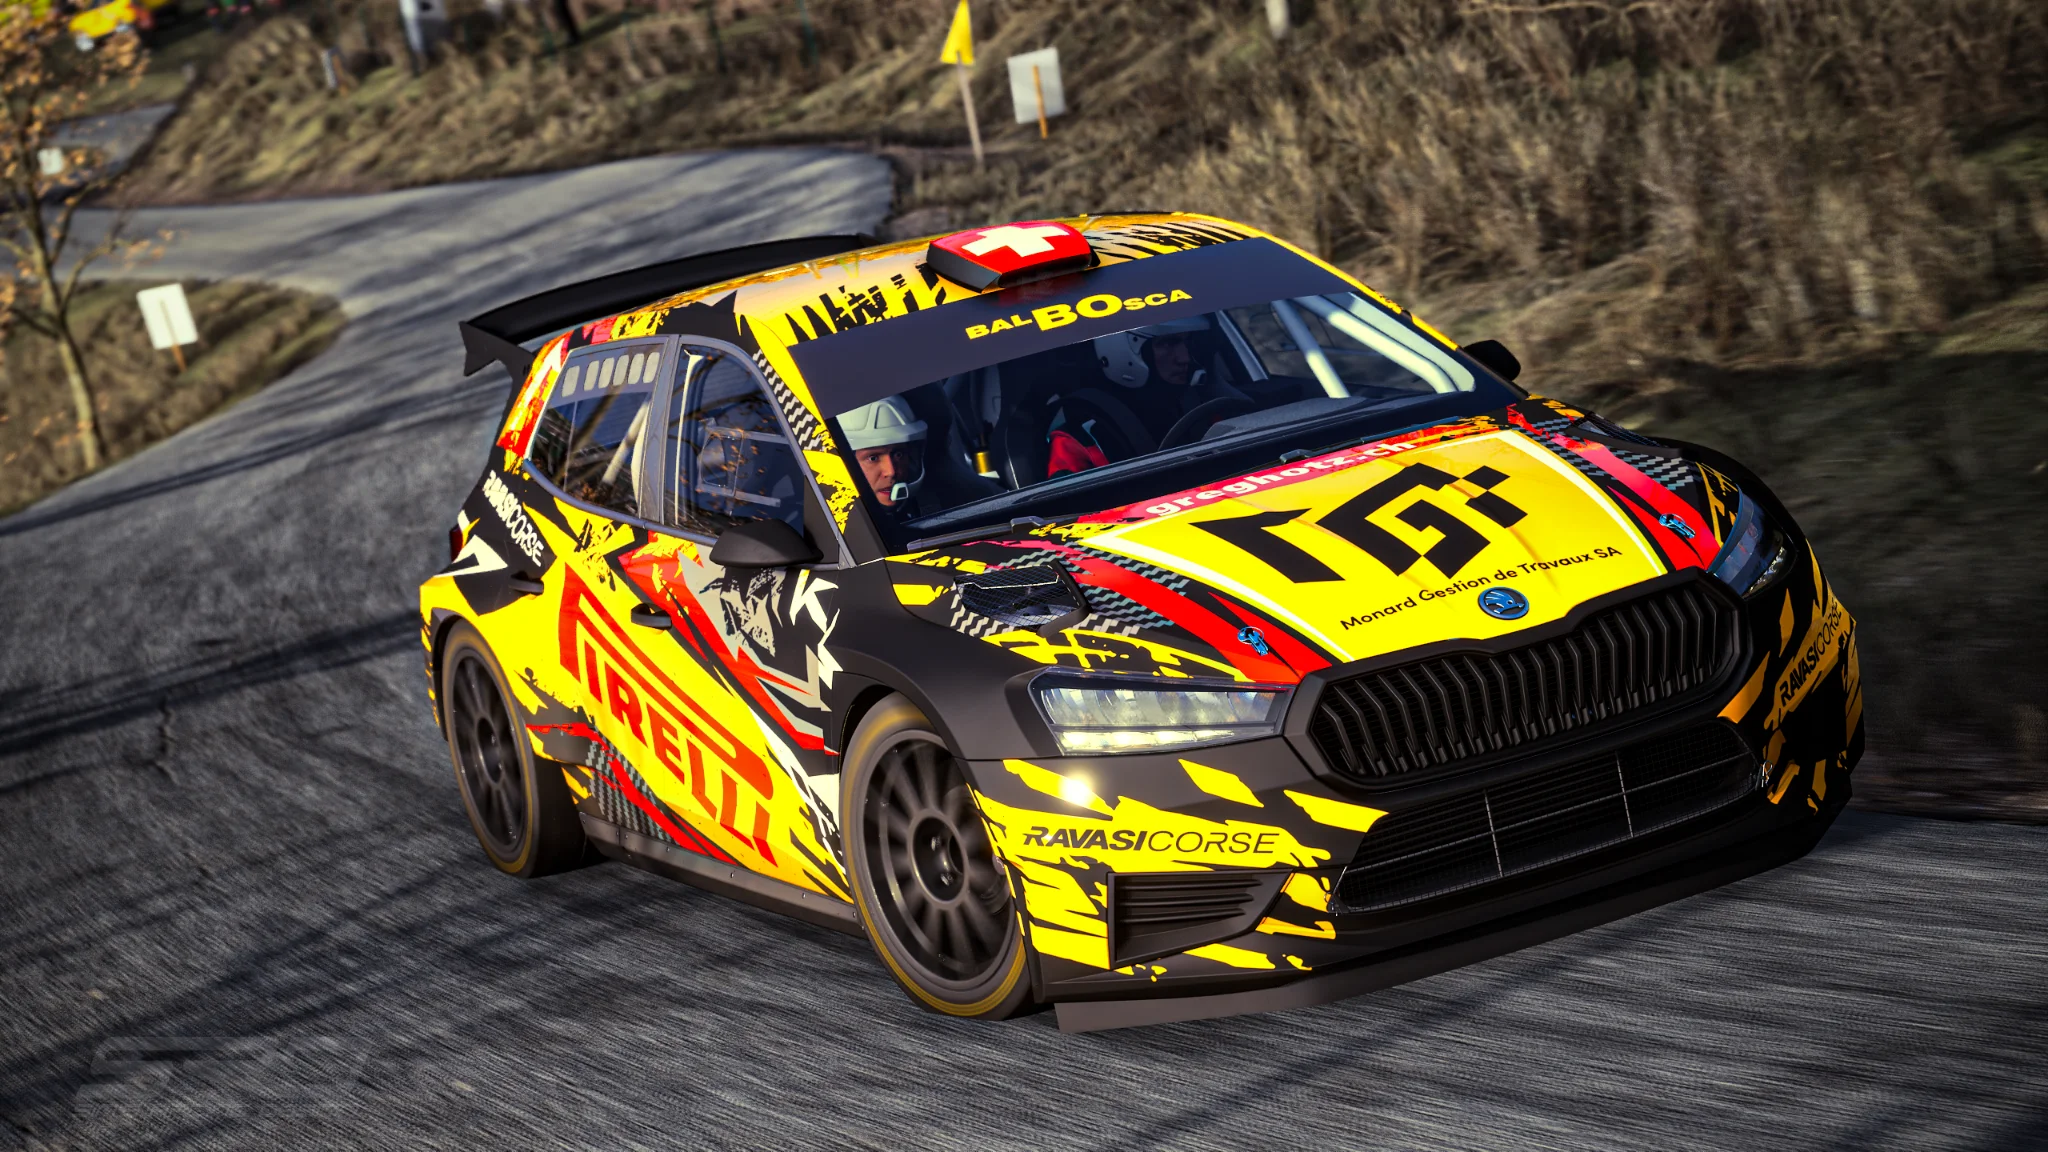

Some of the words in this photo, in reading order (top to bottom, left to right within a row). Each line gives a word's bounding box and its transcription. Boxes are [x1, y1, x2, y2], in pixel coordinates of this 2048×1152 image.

[1146, 441, 1417, 517] greghotz.ch
[1340, 596, 1418, 630] Monard
[1418, 574, 1492, 602] Gestion
[1493, 569, 1519, 582] de
[1517, 552, 1594, 575] Travaux
[1593, 545, 1623, 559] SA
[1780, 597, 1842, 708] RAVASICORSE
[558, 561, 779, 869] PIRELLI
[1022, 825, 1280, 854] RAVASICORSE
